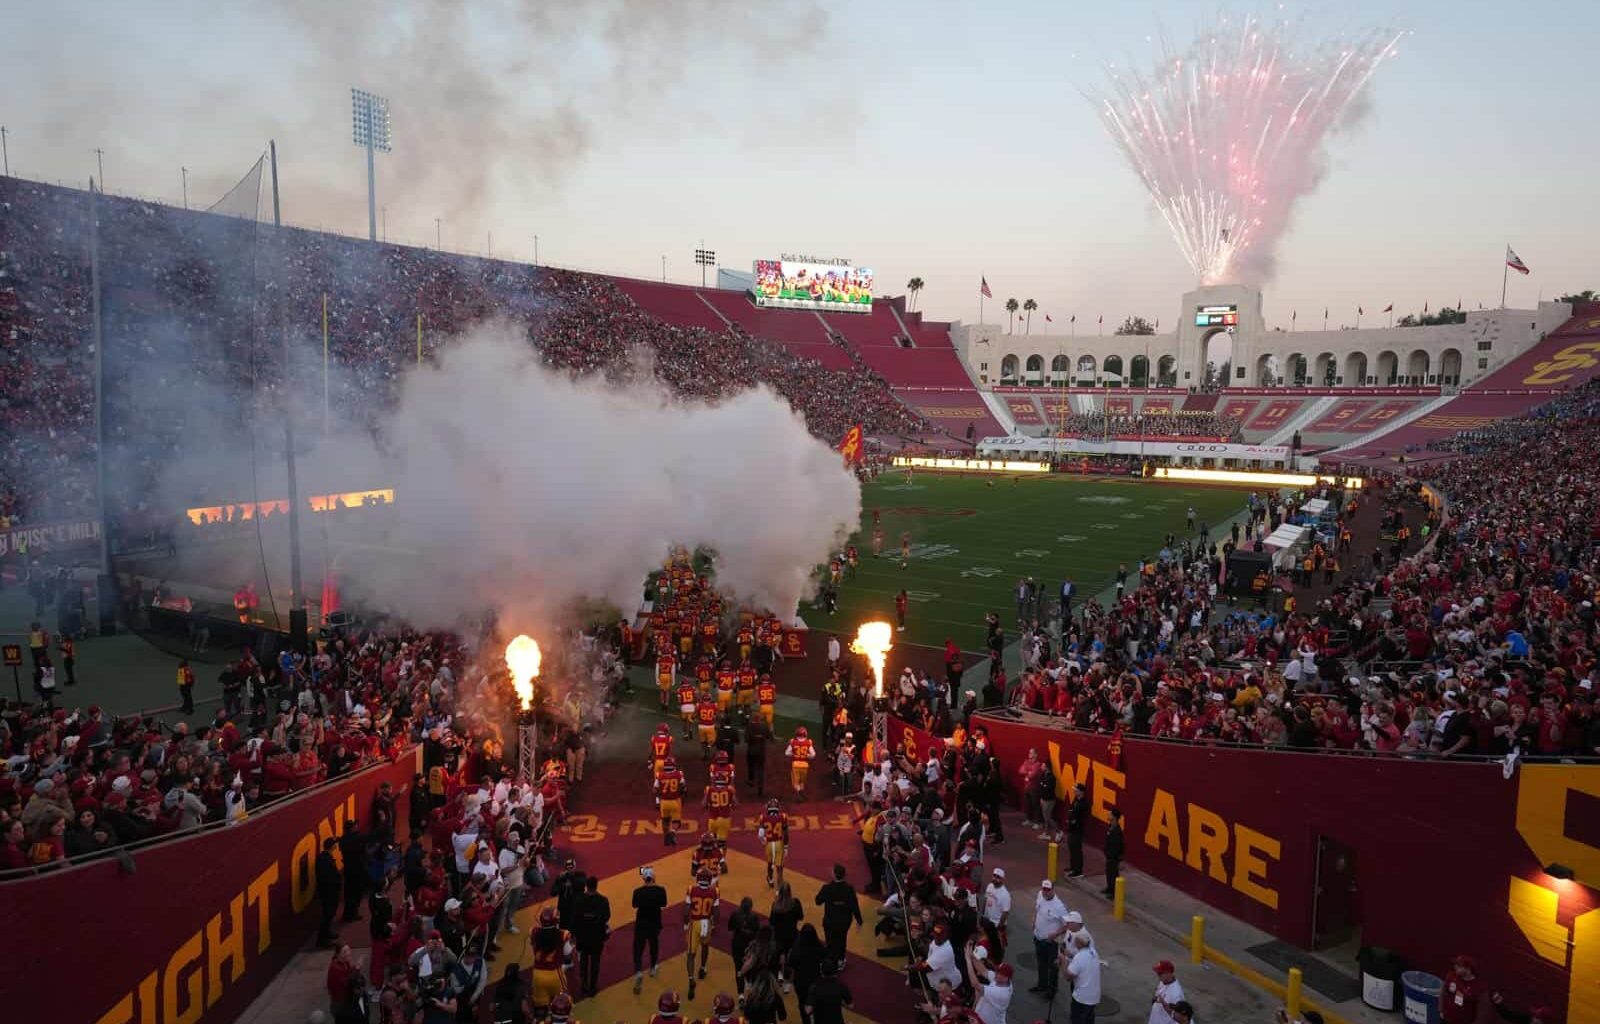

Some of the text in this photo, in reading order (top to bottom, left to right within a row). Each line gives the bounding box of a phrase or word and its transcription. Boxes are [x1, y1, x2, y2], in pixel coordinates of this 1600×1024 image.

[1245, 446, 1287, 454] Audi
[655, 742, 667, 756] 17
[710, 791, 729, 808] 90
[765, 822, 783, 839] 24
[1048, 740, 1281, 911] WE ARE
[692, 896, 712, 916] 30
